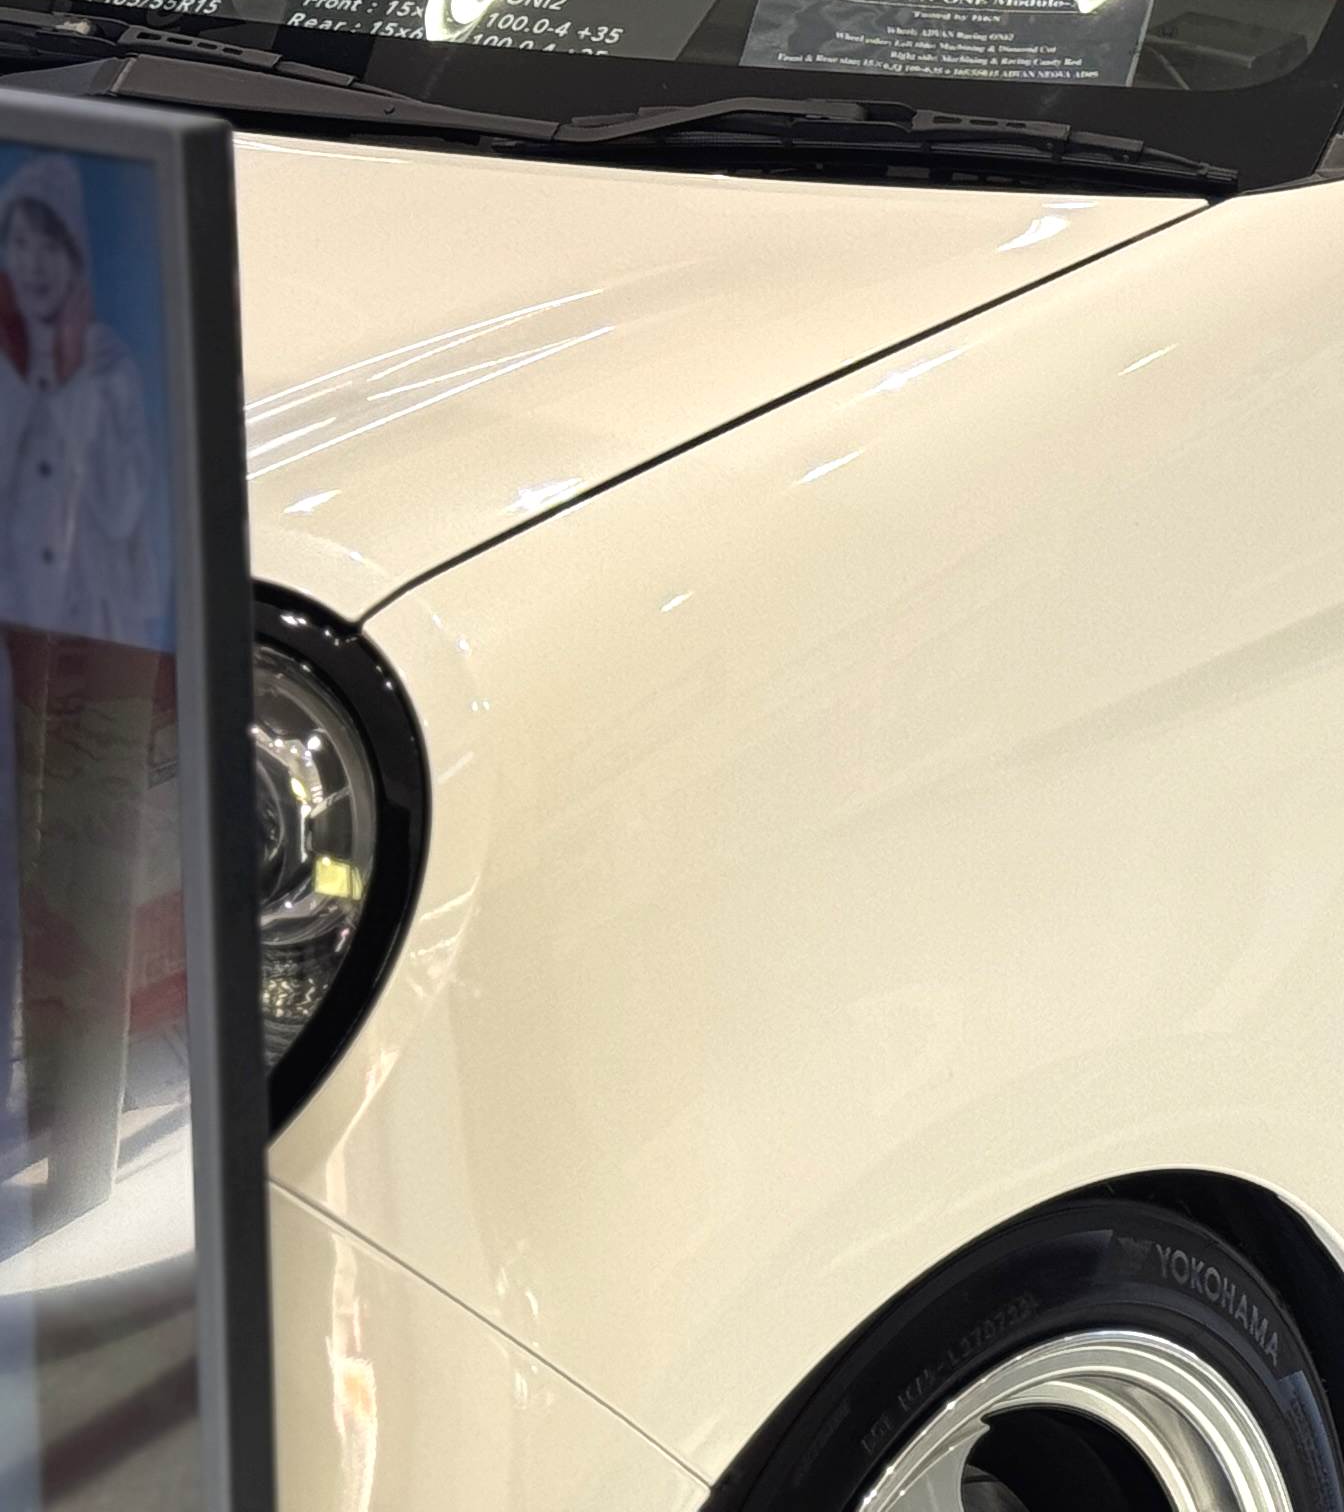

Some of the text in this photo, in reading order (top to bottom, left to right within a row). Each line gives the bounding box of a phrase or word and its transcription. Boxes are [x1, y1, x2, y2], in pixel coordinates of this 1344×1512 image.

[486, 12, 572, 38] 100.0-4
[577, 27, 625, 45] +35
[835, 31, 864, 43] Wheel
[1155, 1243, 1279, 1367] YOKOHAMA
